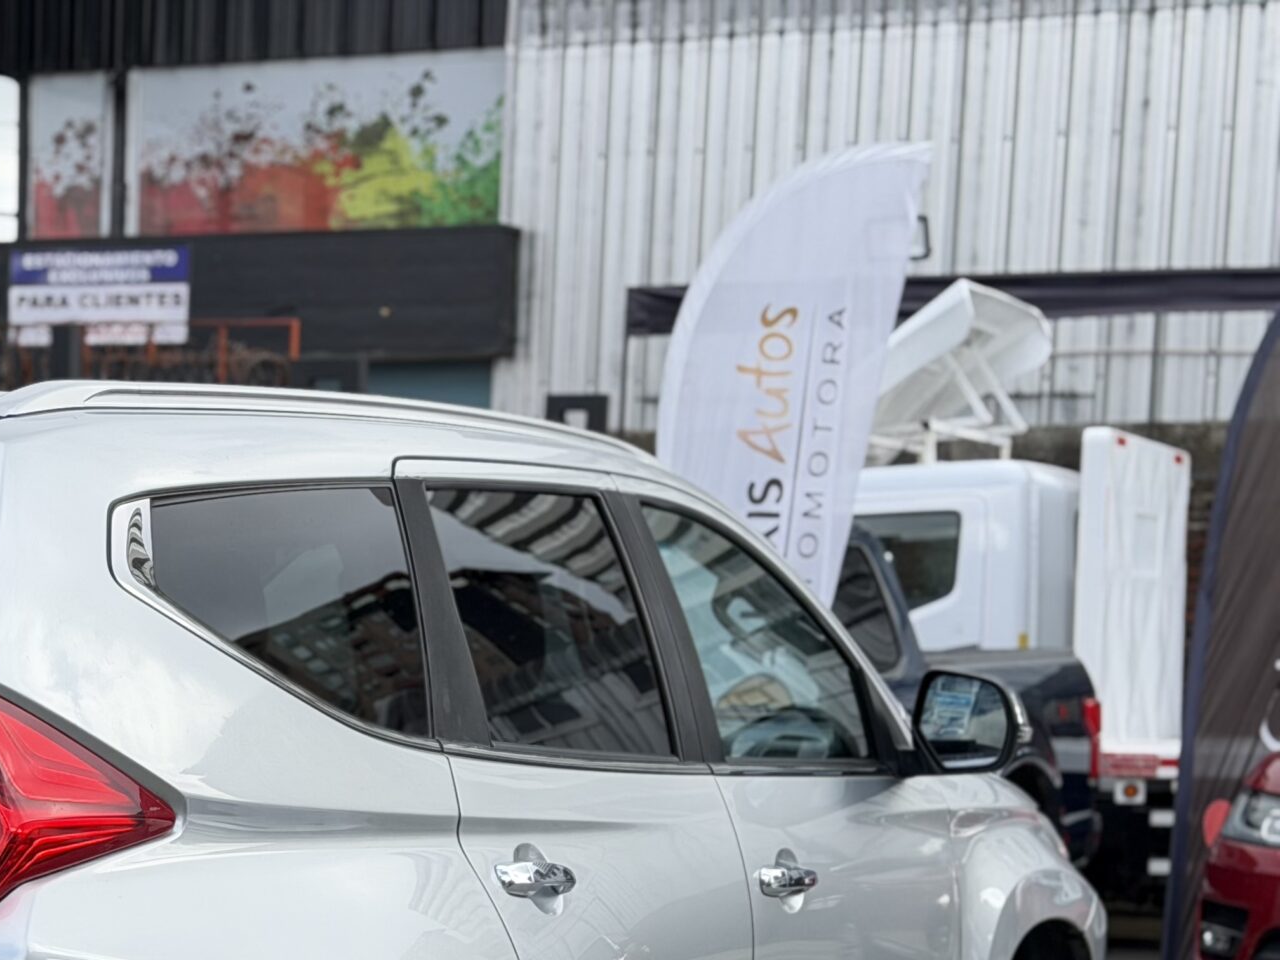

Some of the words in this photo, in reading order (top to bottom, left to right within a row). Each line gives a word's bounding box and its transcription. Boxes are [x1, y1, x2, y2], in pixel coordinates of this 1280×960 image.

[15, 292, 69, 310] PARA
[78, 290, 183, 309] CLIENTES
[736, 304, 799, 465] Autos
